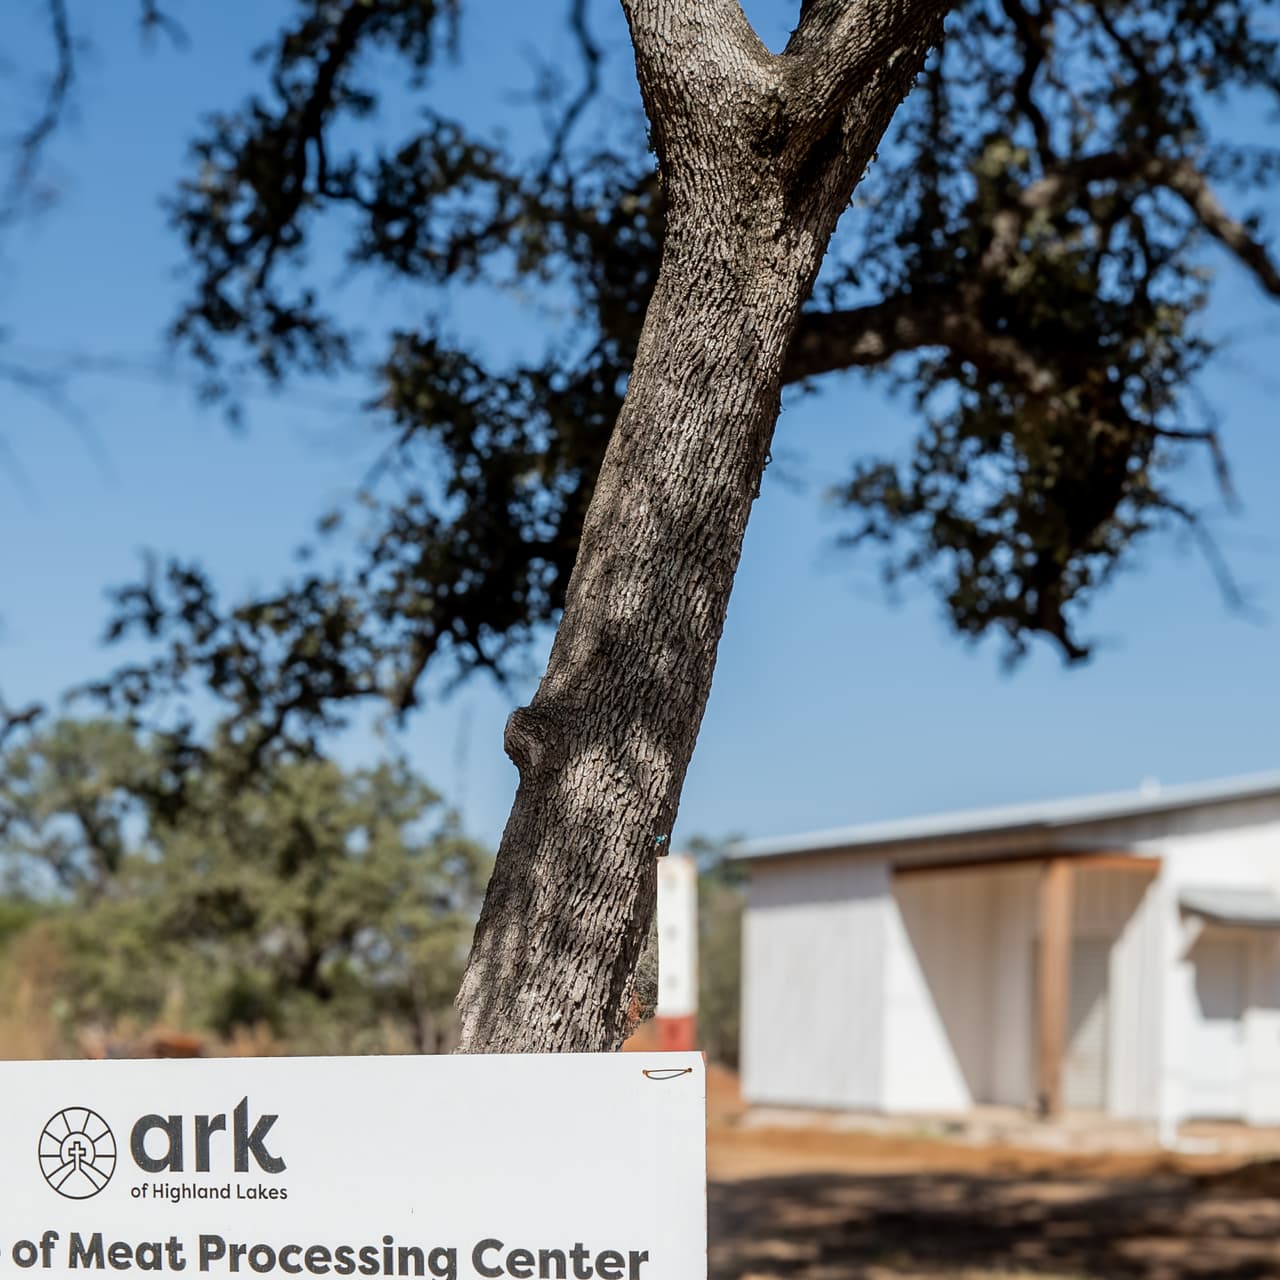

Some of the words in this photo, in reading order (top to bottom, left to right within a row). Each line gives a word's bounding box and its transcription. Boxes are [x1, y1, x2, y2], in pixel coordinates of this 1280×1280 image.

[130, 1096, 287, 1174] ark
[131, 1183, 149, 1199] of
[152, 1183, 231, 1204] Highland
[236, 1183, 288, 1200] Lakes
[12, 1231, 60, 1270] of
[68, 1232, 186, 1271] Meat
